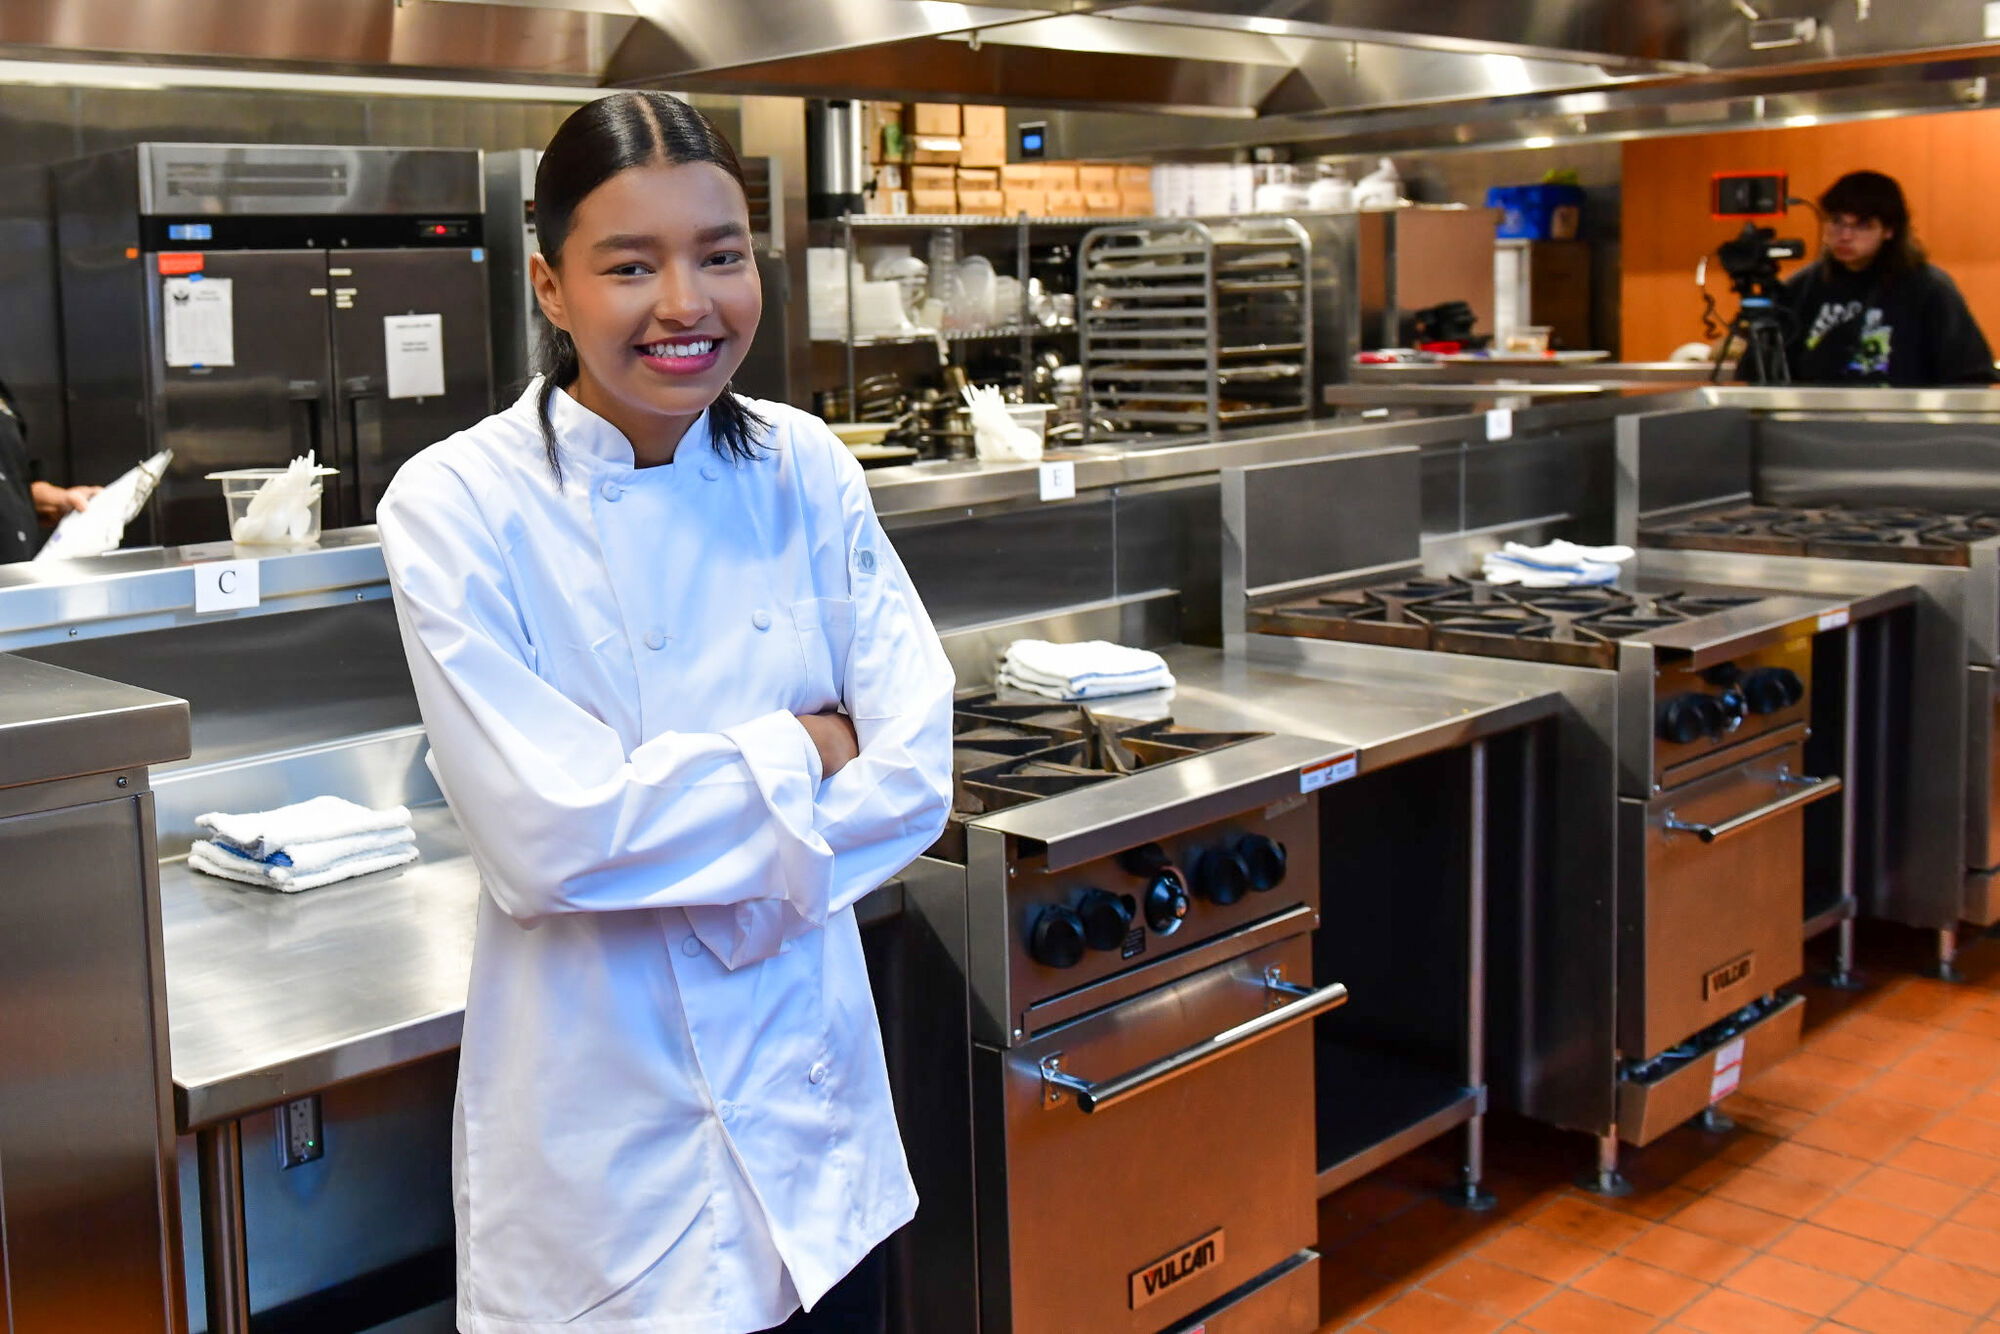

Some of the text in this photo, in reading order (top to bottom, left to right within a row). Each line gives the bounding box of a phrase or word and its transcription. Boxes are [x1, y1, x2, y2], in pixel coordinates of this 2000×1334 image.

[1053, 469, 1063, 487] E
[218, 570, 236, 594] C
[1143, 1240, 1215, 1296] VULCAN
